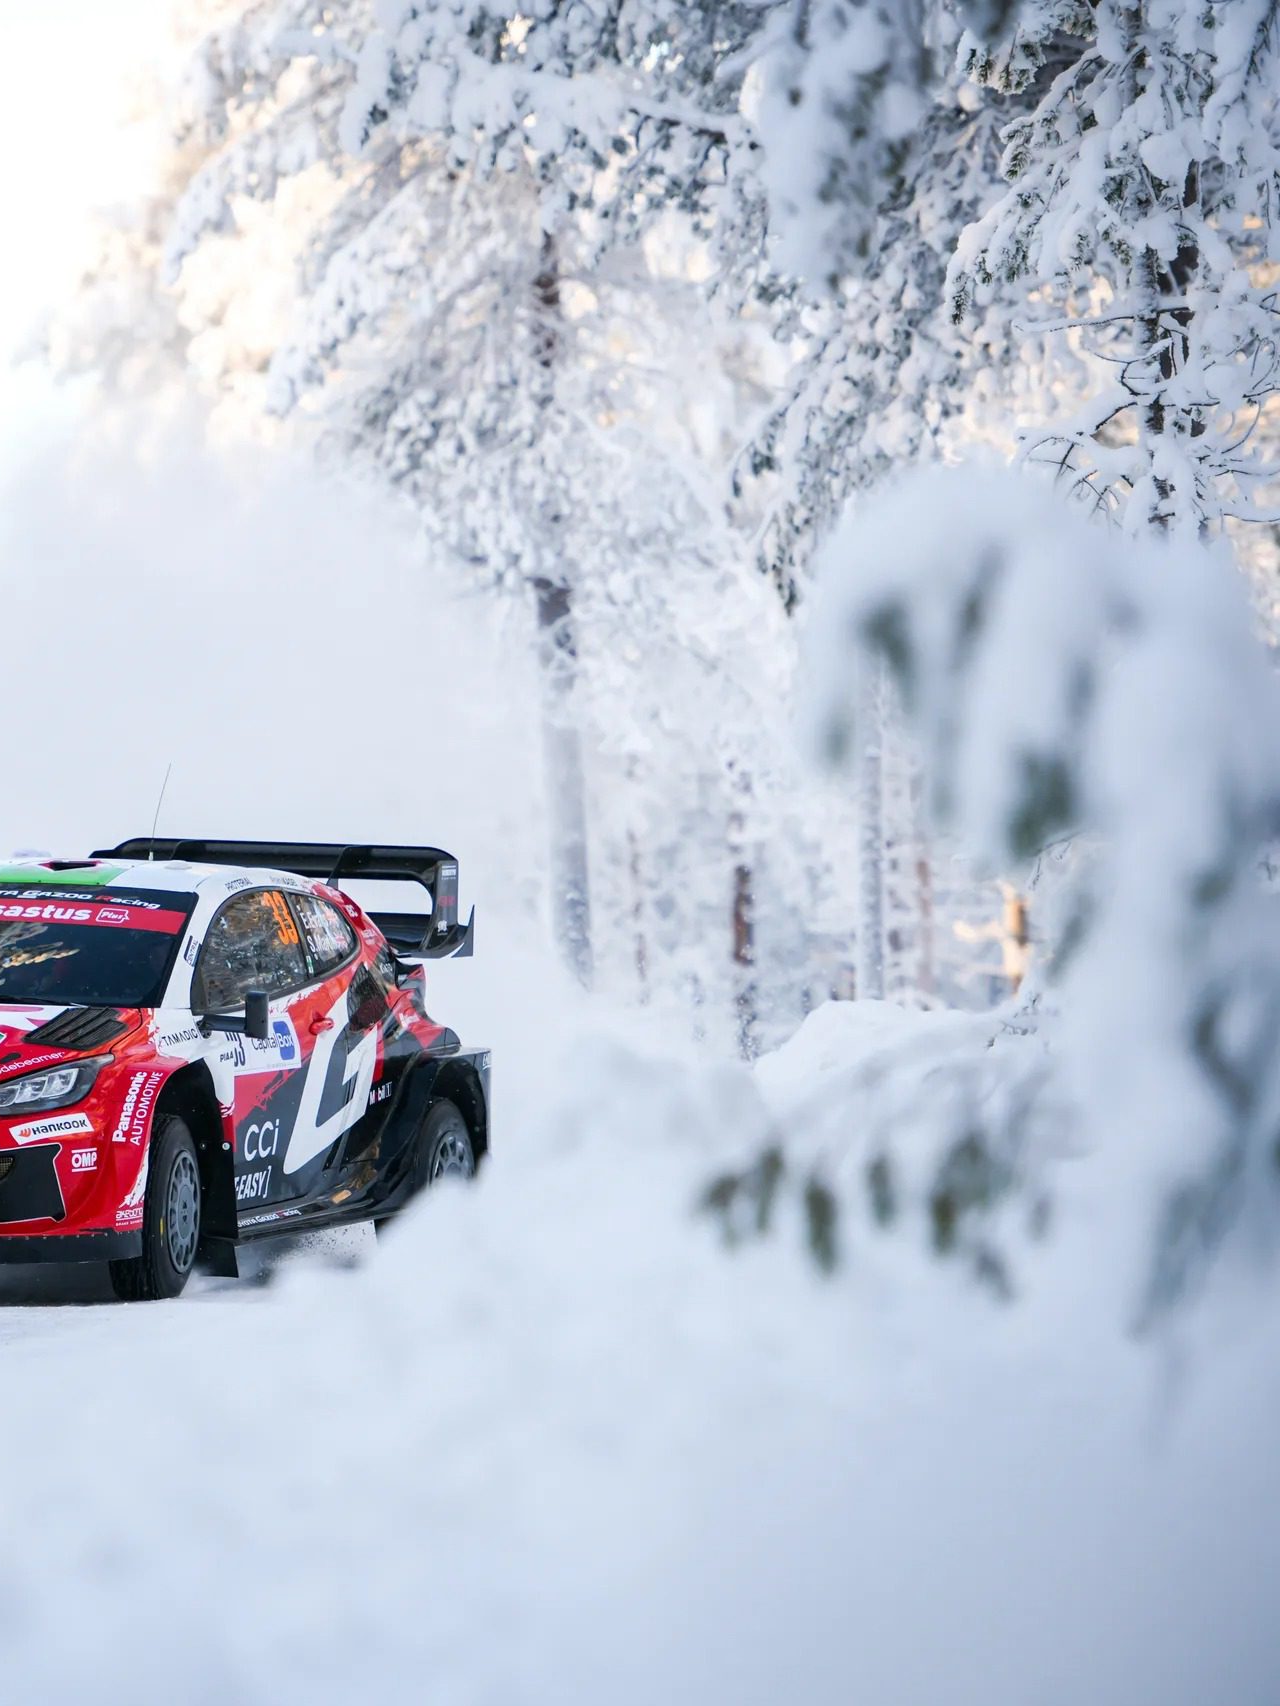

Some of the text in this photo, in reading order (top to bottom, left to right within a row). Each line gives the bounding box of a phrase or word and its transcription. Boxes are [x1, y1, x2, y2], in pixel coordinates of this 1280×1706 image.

[17, 890, 93, 899] GAZOO
[95, 895, 161, 909] Racing
[262, 890, 299, 945] 33
[161, 1028, 199, 1046] TAMADIC
[112, 1071, 148, 1143] Panasonic
[130, 1071, 163, 1146] AUTOMOTIVE
[71, 1151, 98, 1169] OMP
